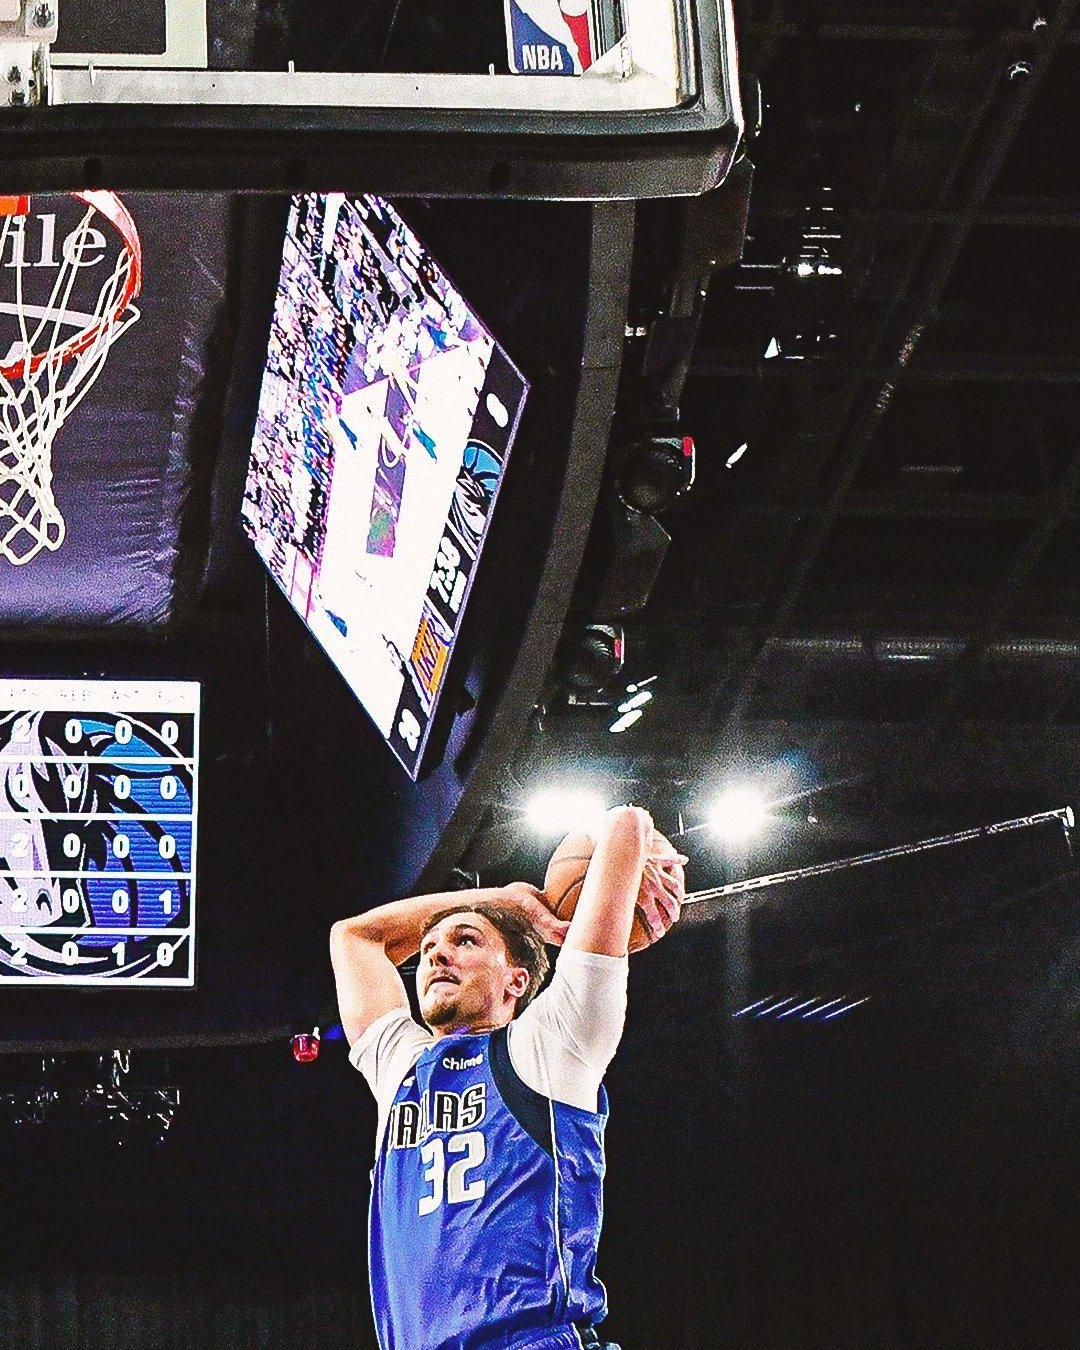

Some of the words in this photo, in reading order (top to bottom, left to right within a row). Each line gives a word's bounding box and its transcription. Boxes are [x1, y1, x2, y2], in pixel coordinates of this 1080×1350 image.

[521, 44, 564, 71] NBA
[64, 718, 83, 743] 0
[115, 719, 133, 744] 0
[161, 719, 179, 744] 0
[12, 772, 30, 798] 0
[63, 772, 82, 798] 0
[114, 773, 132, 799] 0
[160, 773, 178, 799] 0
[63, 832, 81, 857] 0
[112, 833, 130, 858] 0
[158, 833, 176, 858] 0
[10, 888, 28, 913] 2
[62, 888, 80, 913] 0
[111, 889, 129, 914] 0
[158, 889, 172, 914] 1
[9, 940, 27, 965] 2
[61, 940, 79, 965] 0
[112, 941, 126, 966] 1
[156, 941, 174, 966] 0
[418, 1130, 487, 1216] 32
